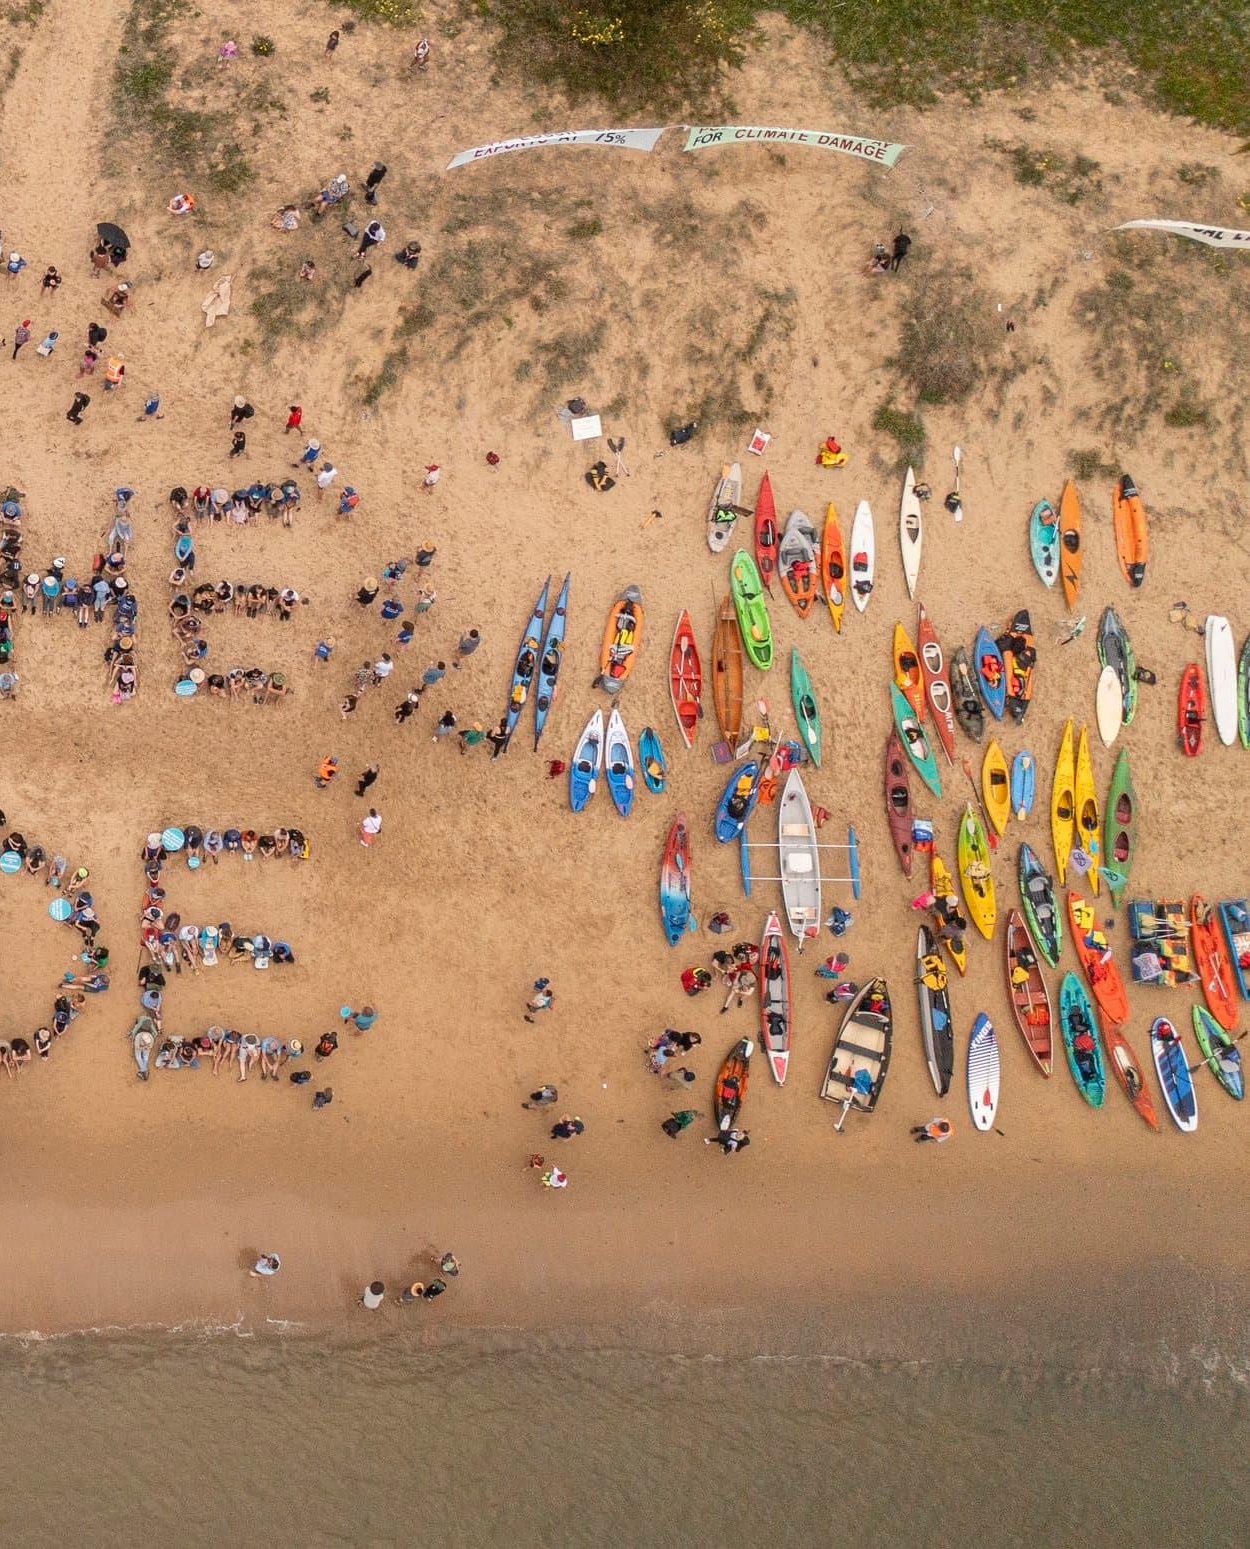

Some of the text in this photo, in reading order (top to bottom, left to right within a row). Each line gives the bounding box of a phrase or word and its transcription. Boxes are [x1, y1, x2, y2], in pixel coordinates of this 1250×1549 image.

[693, 131, 724, 147] FOR
[817, 135, 888, 160] DAMAGE
[971, 1019, 992, 1050] KINGS
